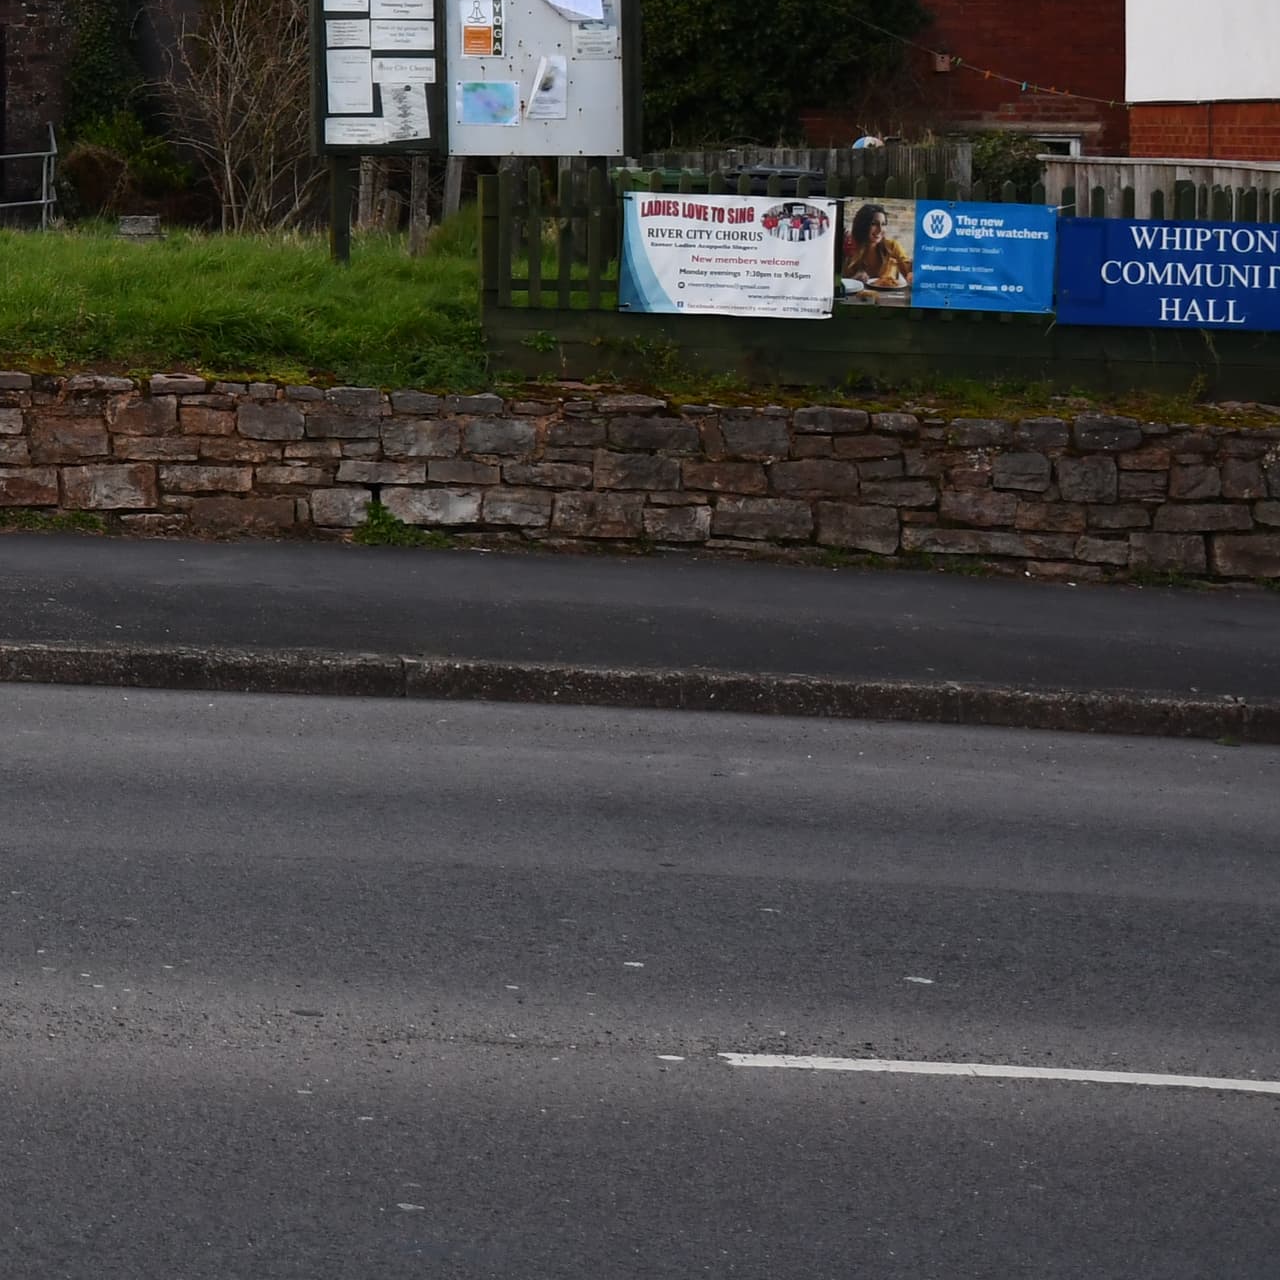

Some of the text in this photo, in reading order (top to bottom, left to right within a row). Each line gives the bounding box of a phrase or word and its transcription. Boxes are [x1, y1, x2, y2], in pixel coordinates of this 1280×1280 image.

[493, 3, 503, 52] YOGA
[641, 200, 755, 224] LADIES LOVE TO SING
[956, 215, 1003, 227] The new
[647, 228, 763, 242] RIVER CITY CHORUS
[955, 227, 1049, 240] weight watchers
[1129, 226, 1279, 253] WHIPTON
[691, 255, 800, 267] New members welcome
[679, 268, 707, 277] Monday
[710, 269, 741, 279] evenings
[745, 270, 772, 280] 7:30pm
[784, 272, 811, 280] 9:45pm
[1159, 297, 1245, 323] HALL
